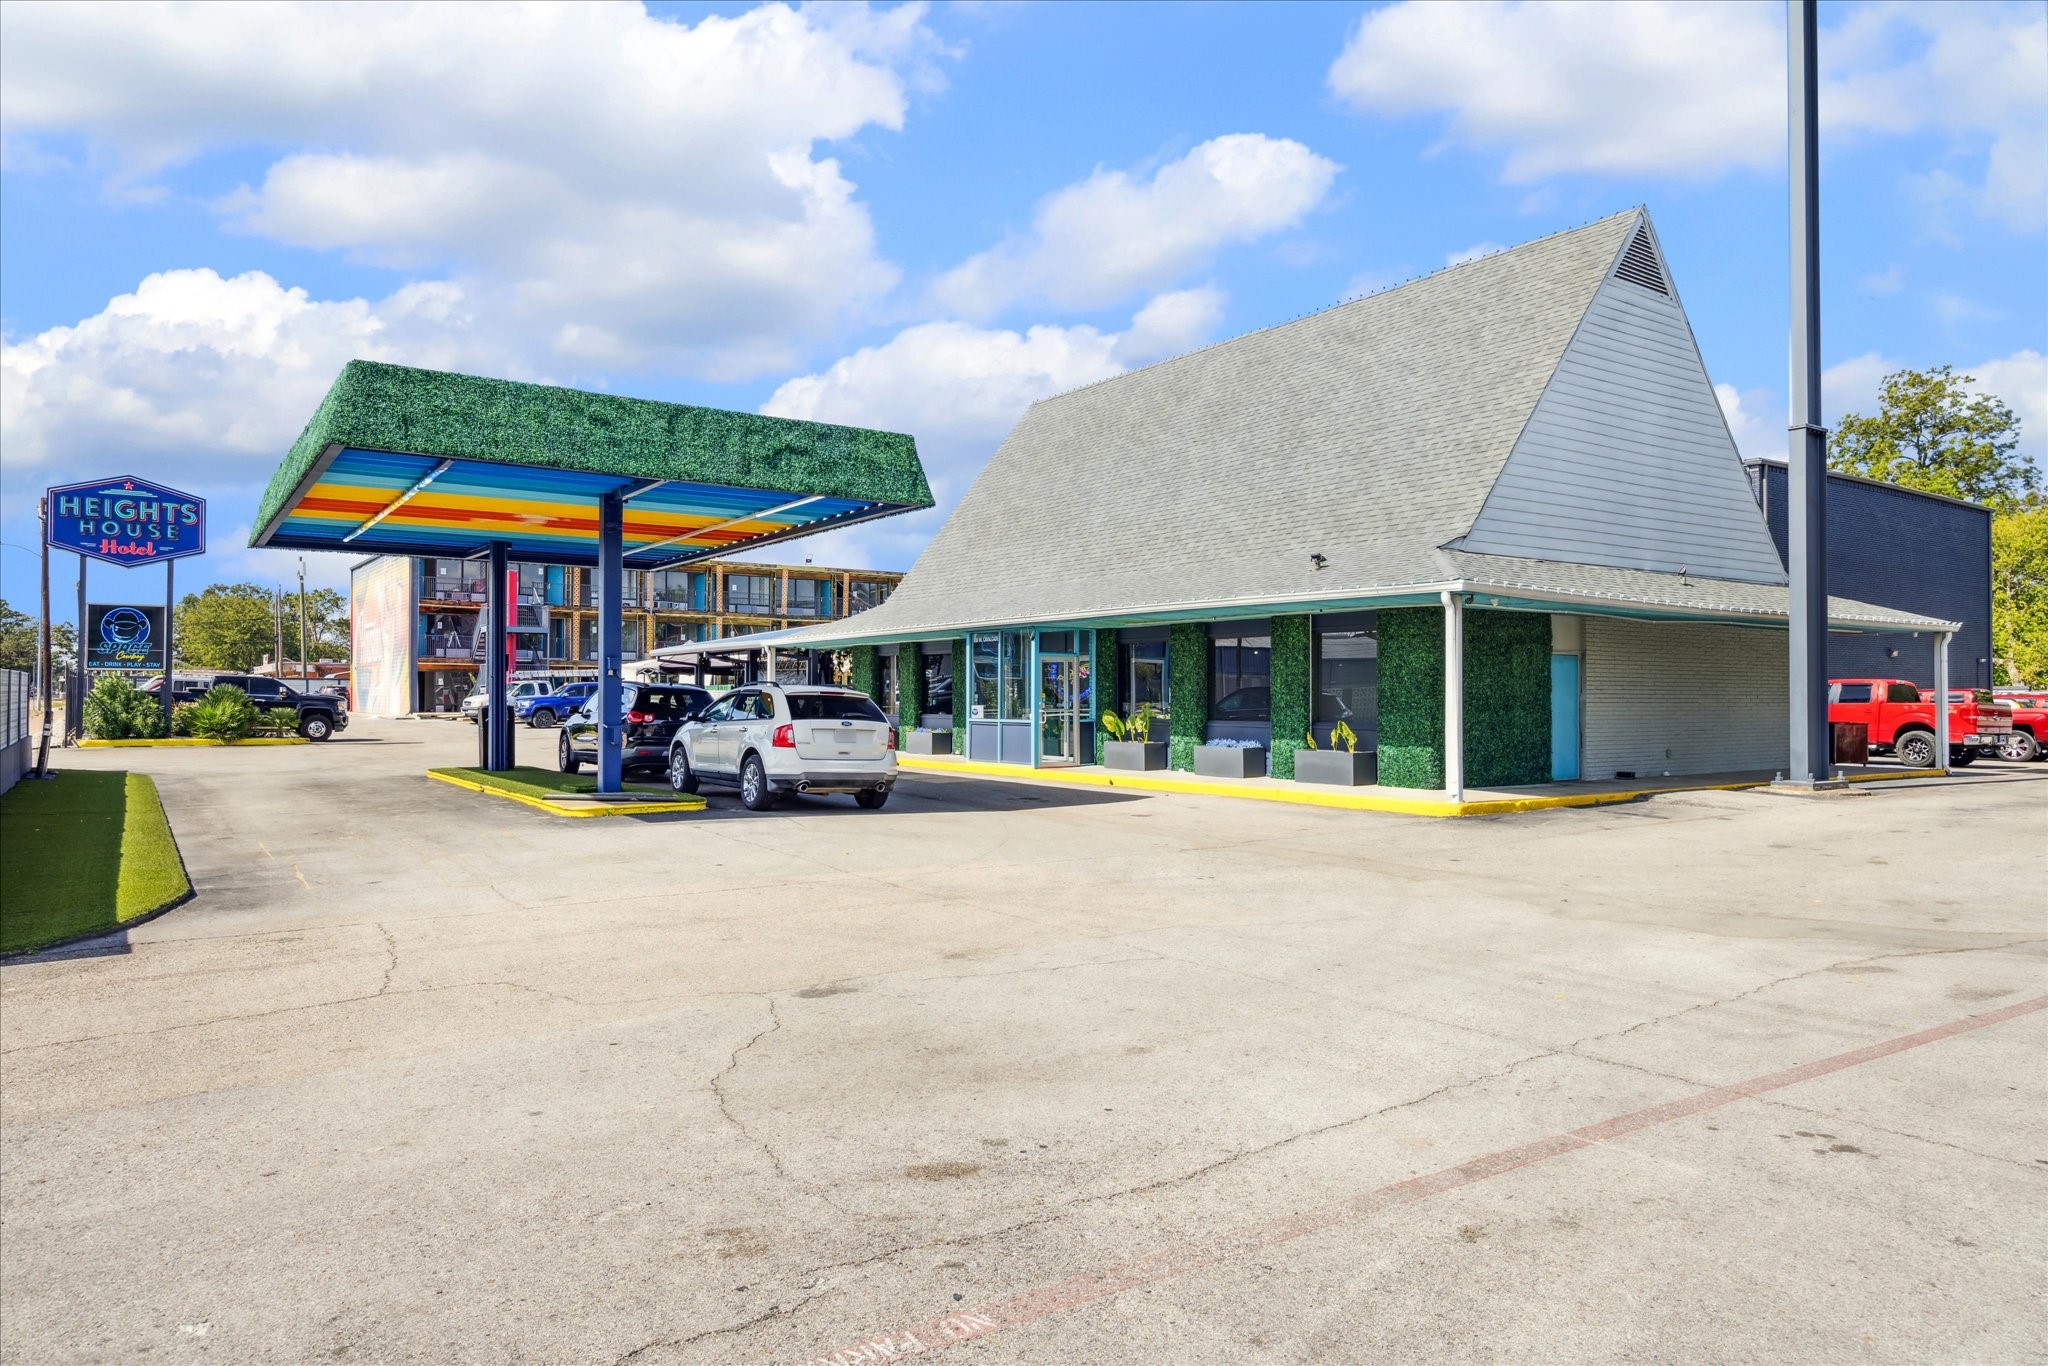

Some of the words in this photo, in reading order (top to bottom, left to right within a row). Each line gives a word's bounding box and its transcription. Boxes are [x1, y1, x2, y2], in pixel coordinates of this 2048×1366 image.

[60, 496, 199, 526] HEIGHTS
[80, 521, 179, 541] HOUSE
[100, 538, 156, 556] Hotel
[97, 642, 153, 655] SPACE
[116, 649, 145, 661] Cowboy
